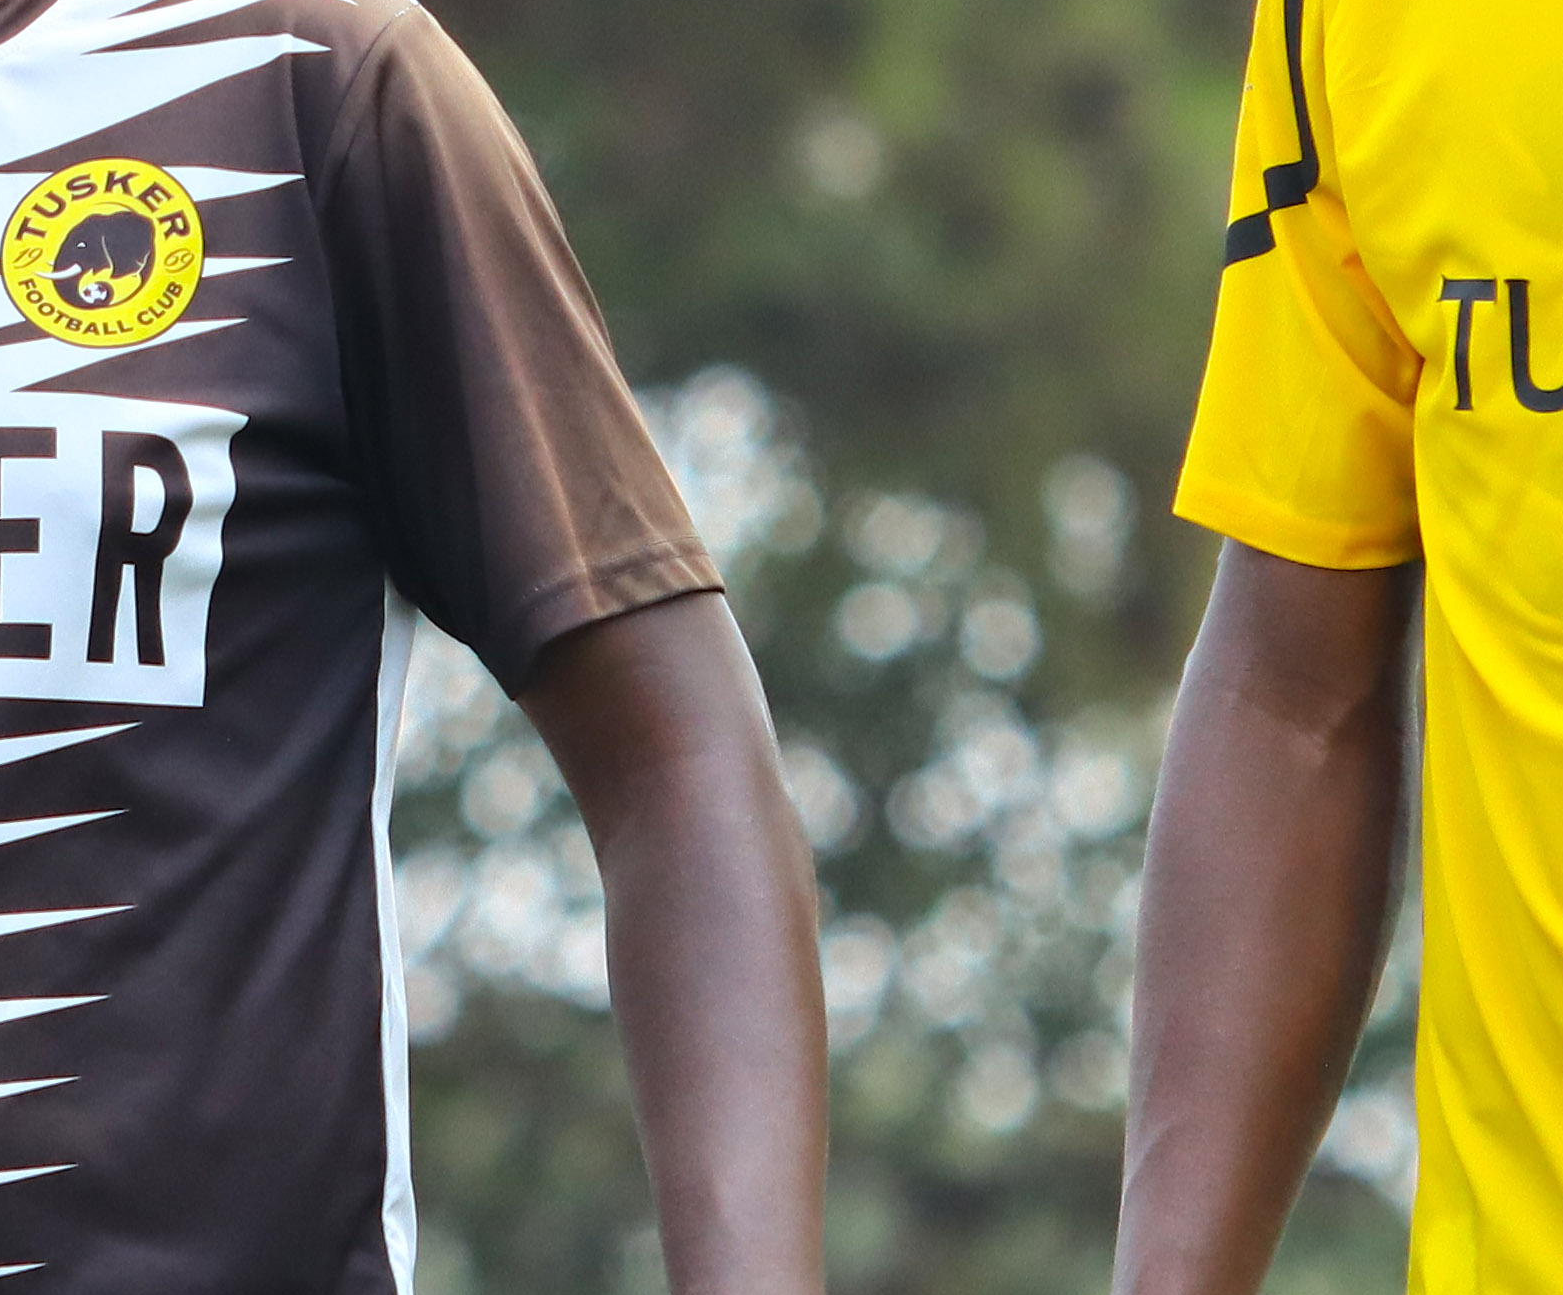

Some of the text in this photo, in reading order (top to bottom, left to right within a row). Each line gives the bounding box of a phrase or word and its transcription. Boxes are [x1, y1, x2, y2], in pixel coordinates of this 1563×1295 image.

[15, 170, 191, 241] TUSKER
[12, 247, 43, 270] 19
[163, 248, 195, 273] 69
[18, 278, 183, 335] FOOTBALL CLUB
